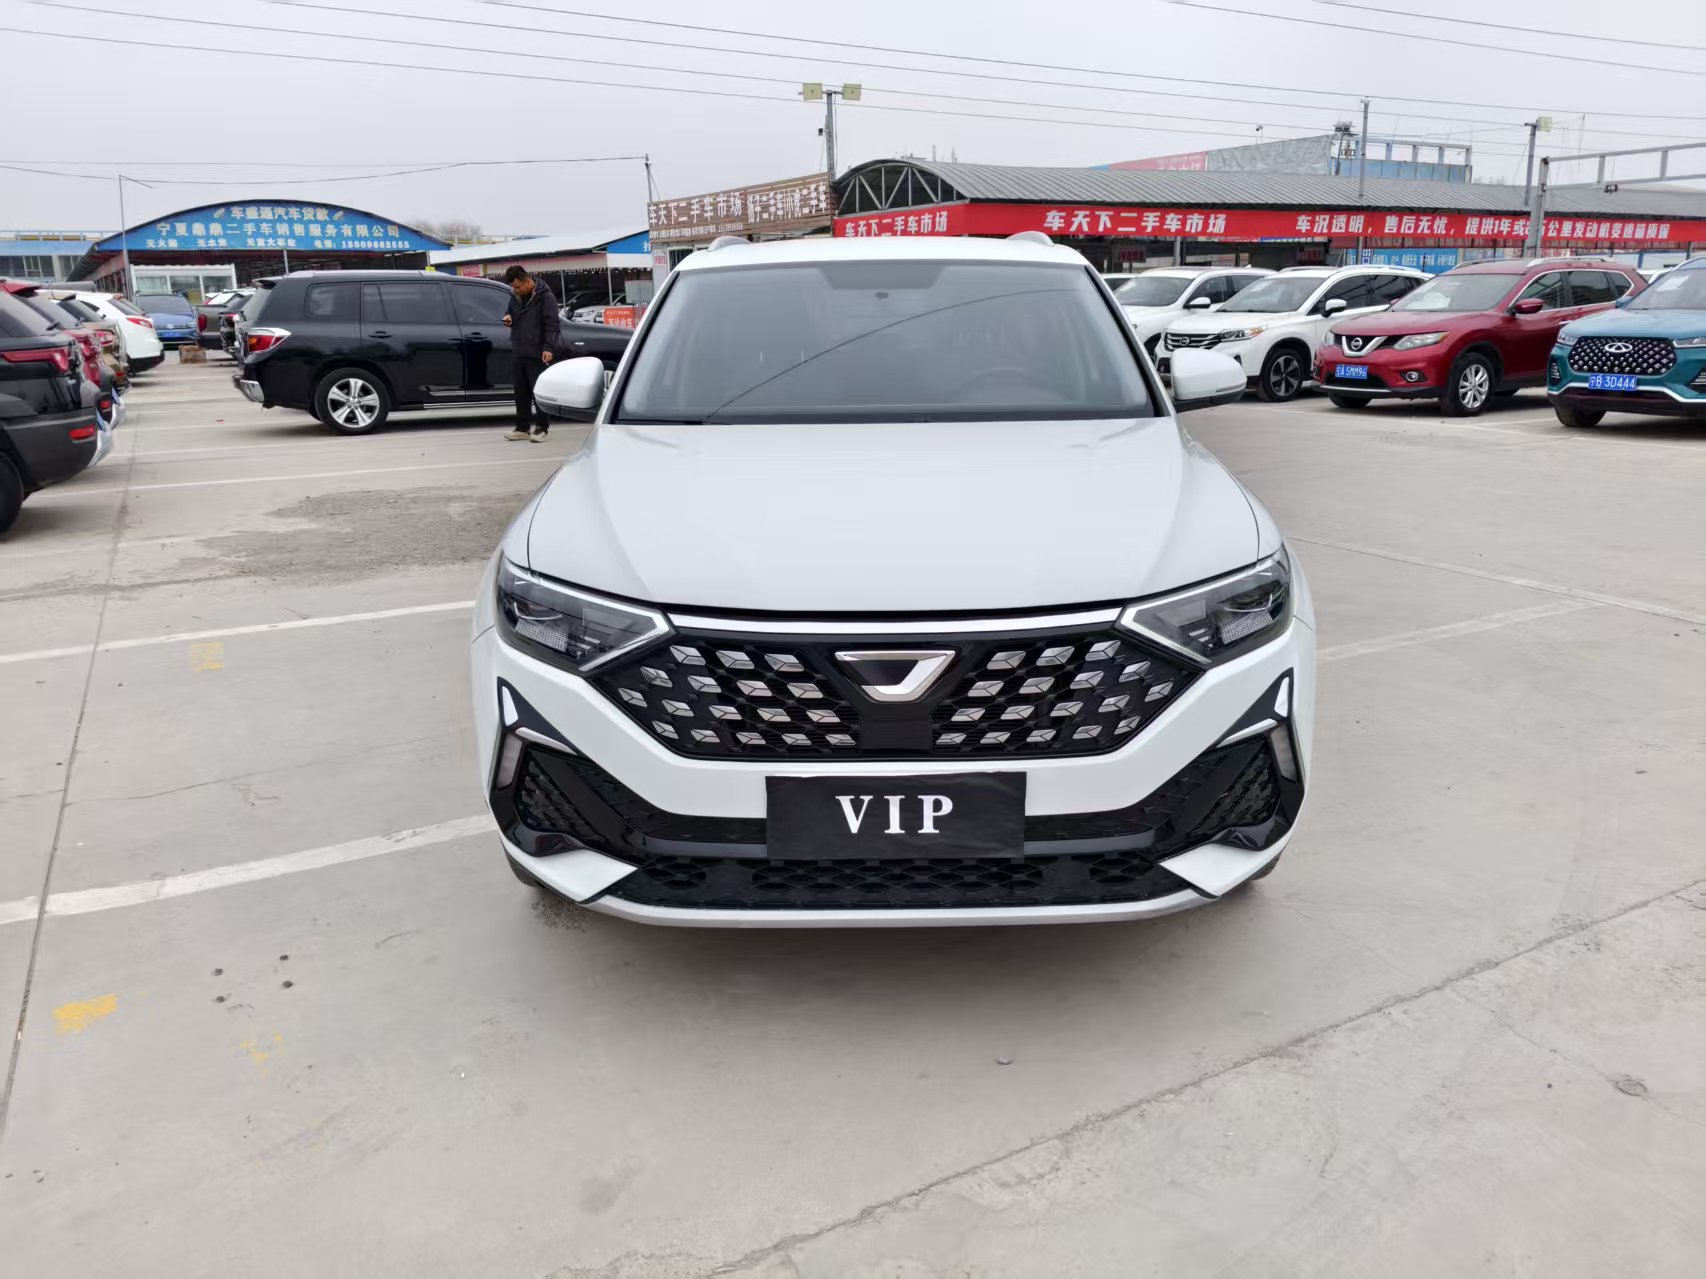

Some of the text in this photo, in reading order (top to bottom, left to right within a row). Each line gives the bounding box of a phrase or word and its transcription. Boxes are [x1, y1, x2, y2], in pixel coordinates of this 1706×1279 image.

[648, 191, 743, 227] 车天下二手车市场
[845, 211, 948, 237] 车天下二手车市场
[1043, 210, 1227, 233] 车天下二手车市场
[835, 795, 953, 834] VIP
